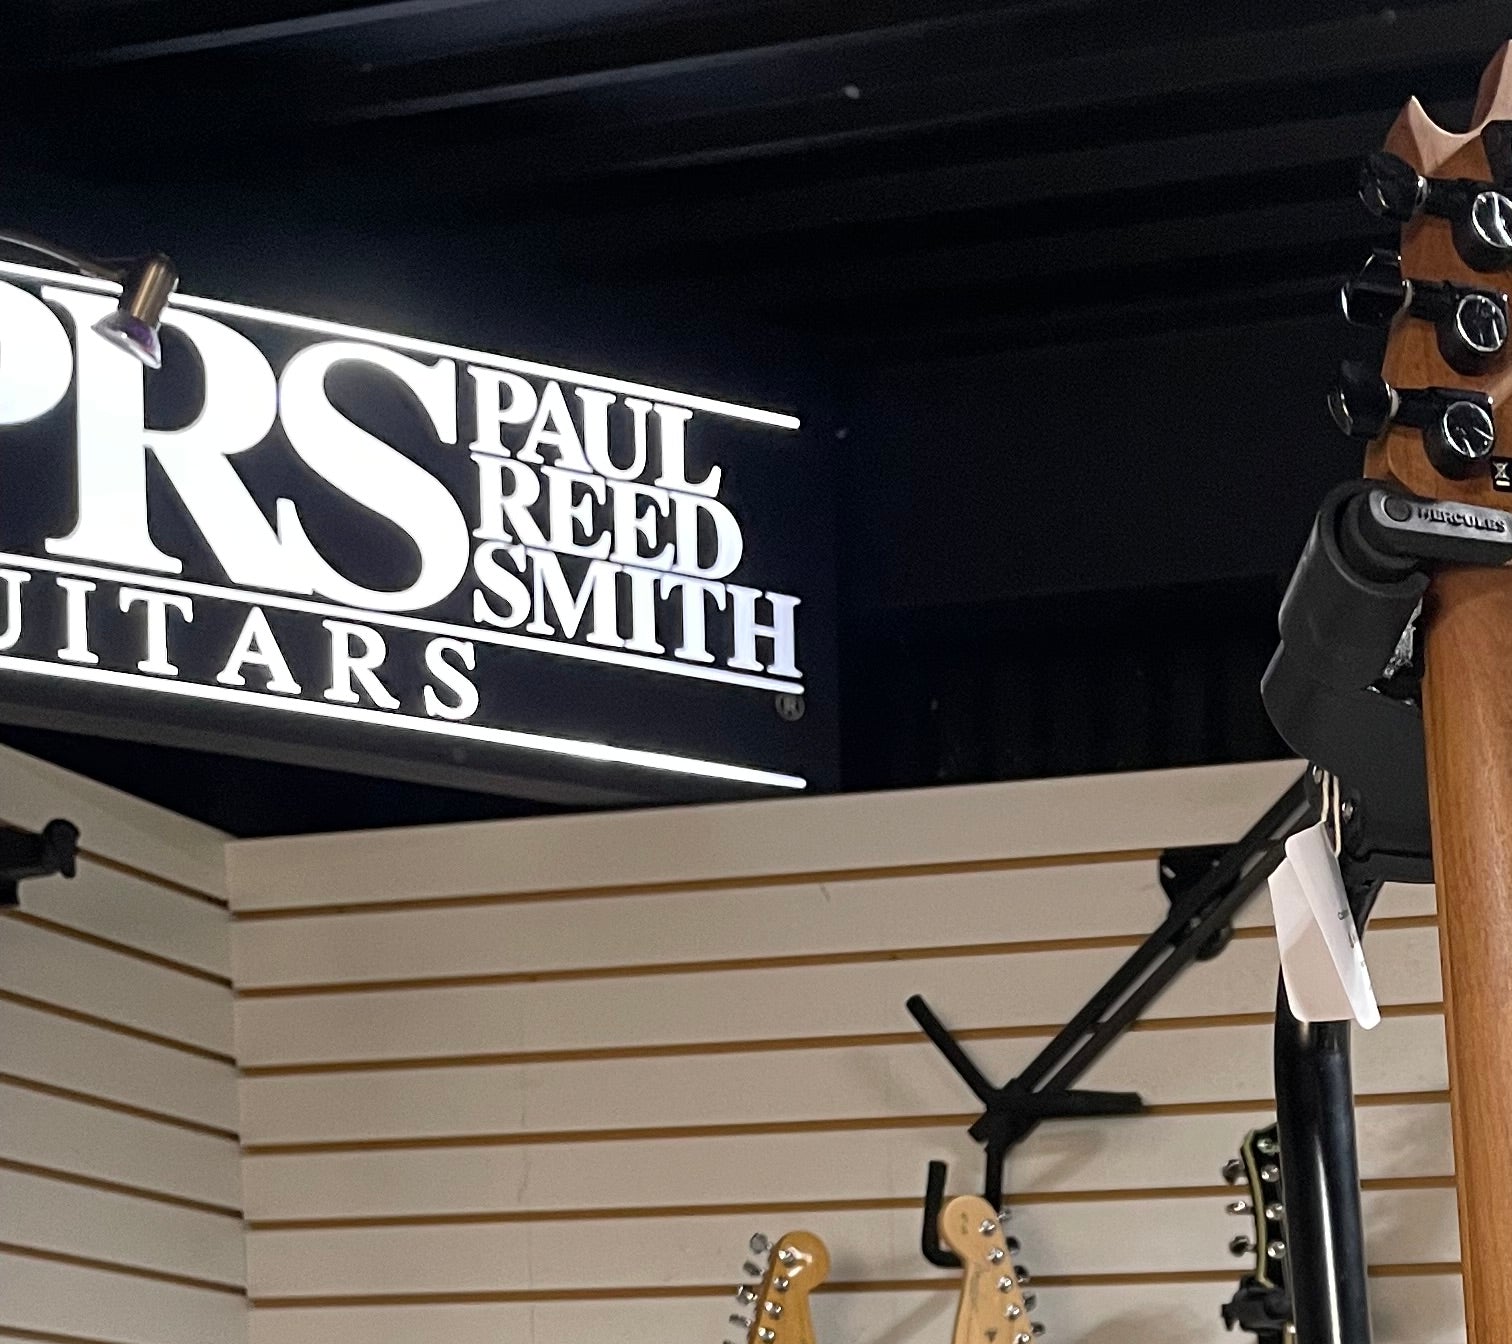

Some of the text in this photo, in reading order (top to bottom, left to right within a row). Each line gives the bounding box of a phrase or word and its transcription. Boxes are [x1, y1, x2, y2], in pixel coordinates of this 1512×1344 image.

[467, 364, 722, 498] PAUL
[470, 452, 744, 580] REED
[1417, 507, 1506, 533] HERCULES
[472, 539, 803, 679] SMITH
